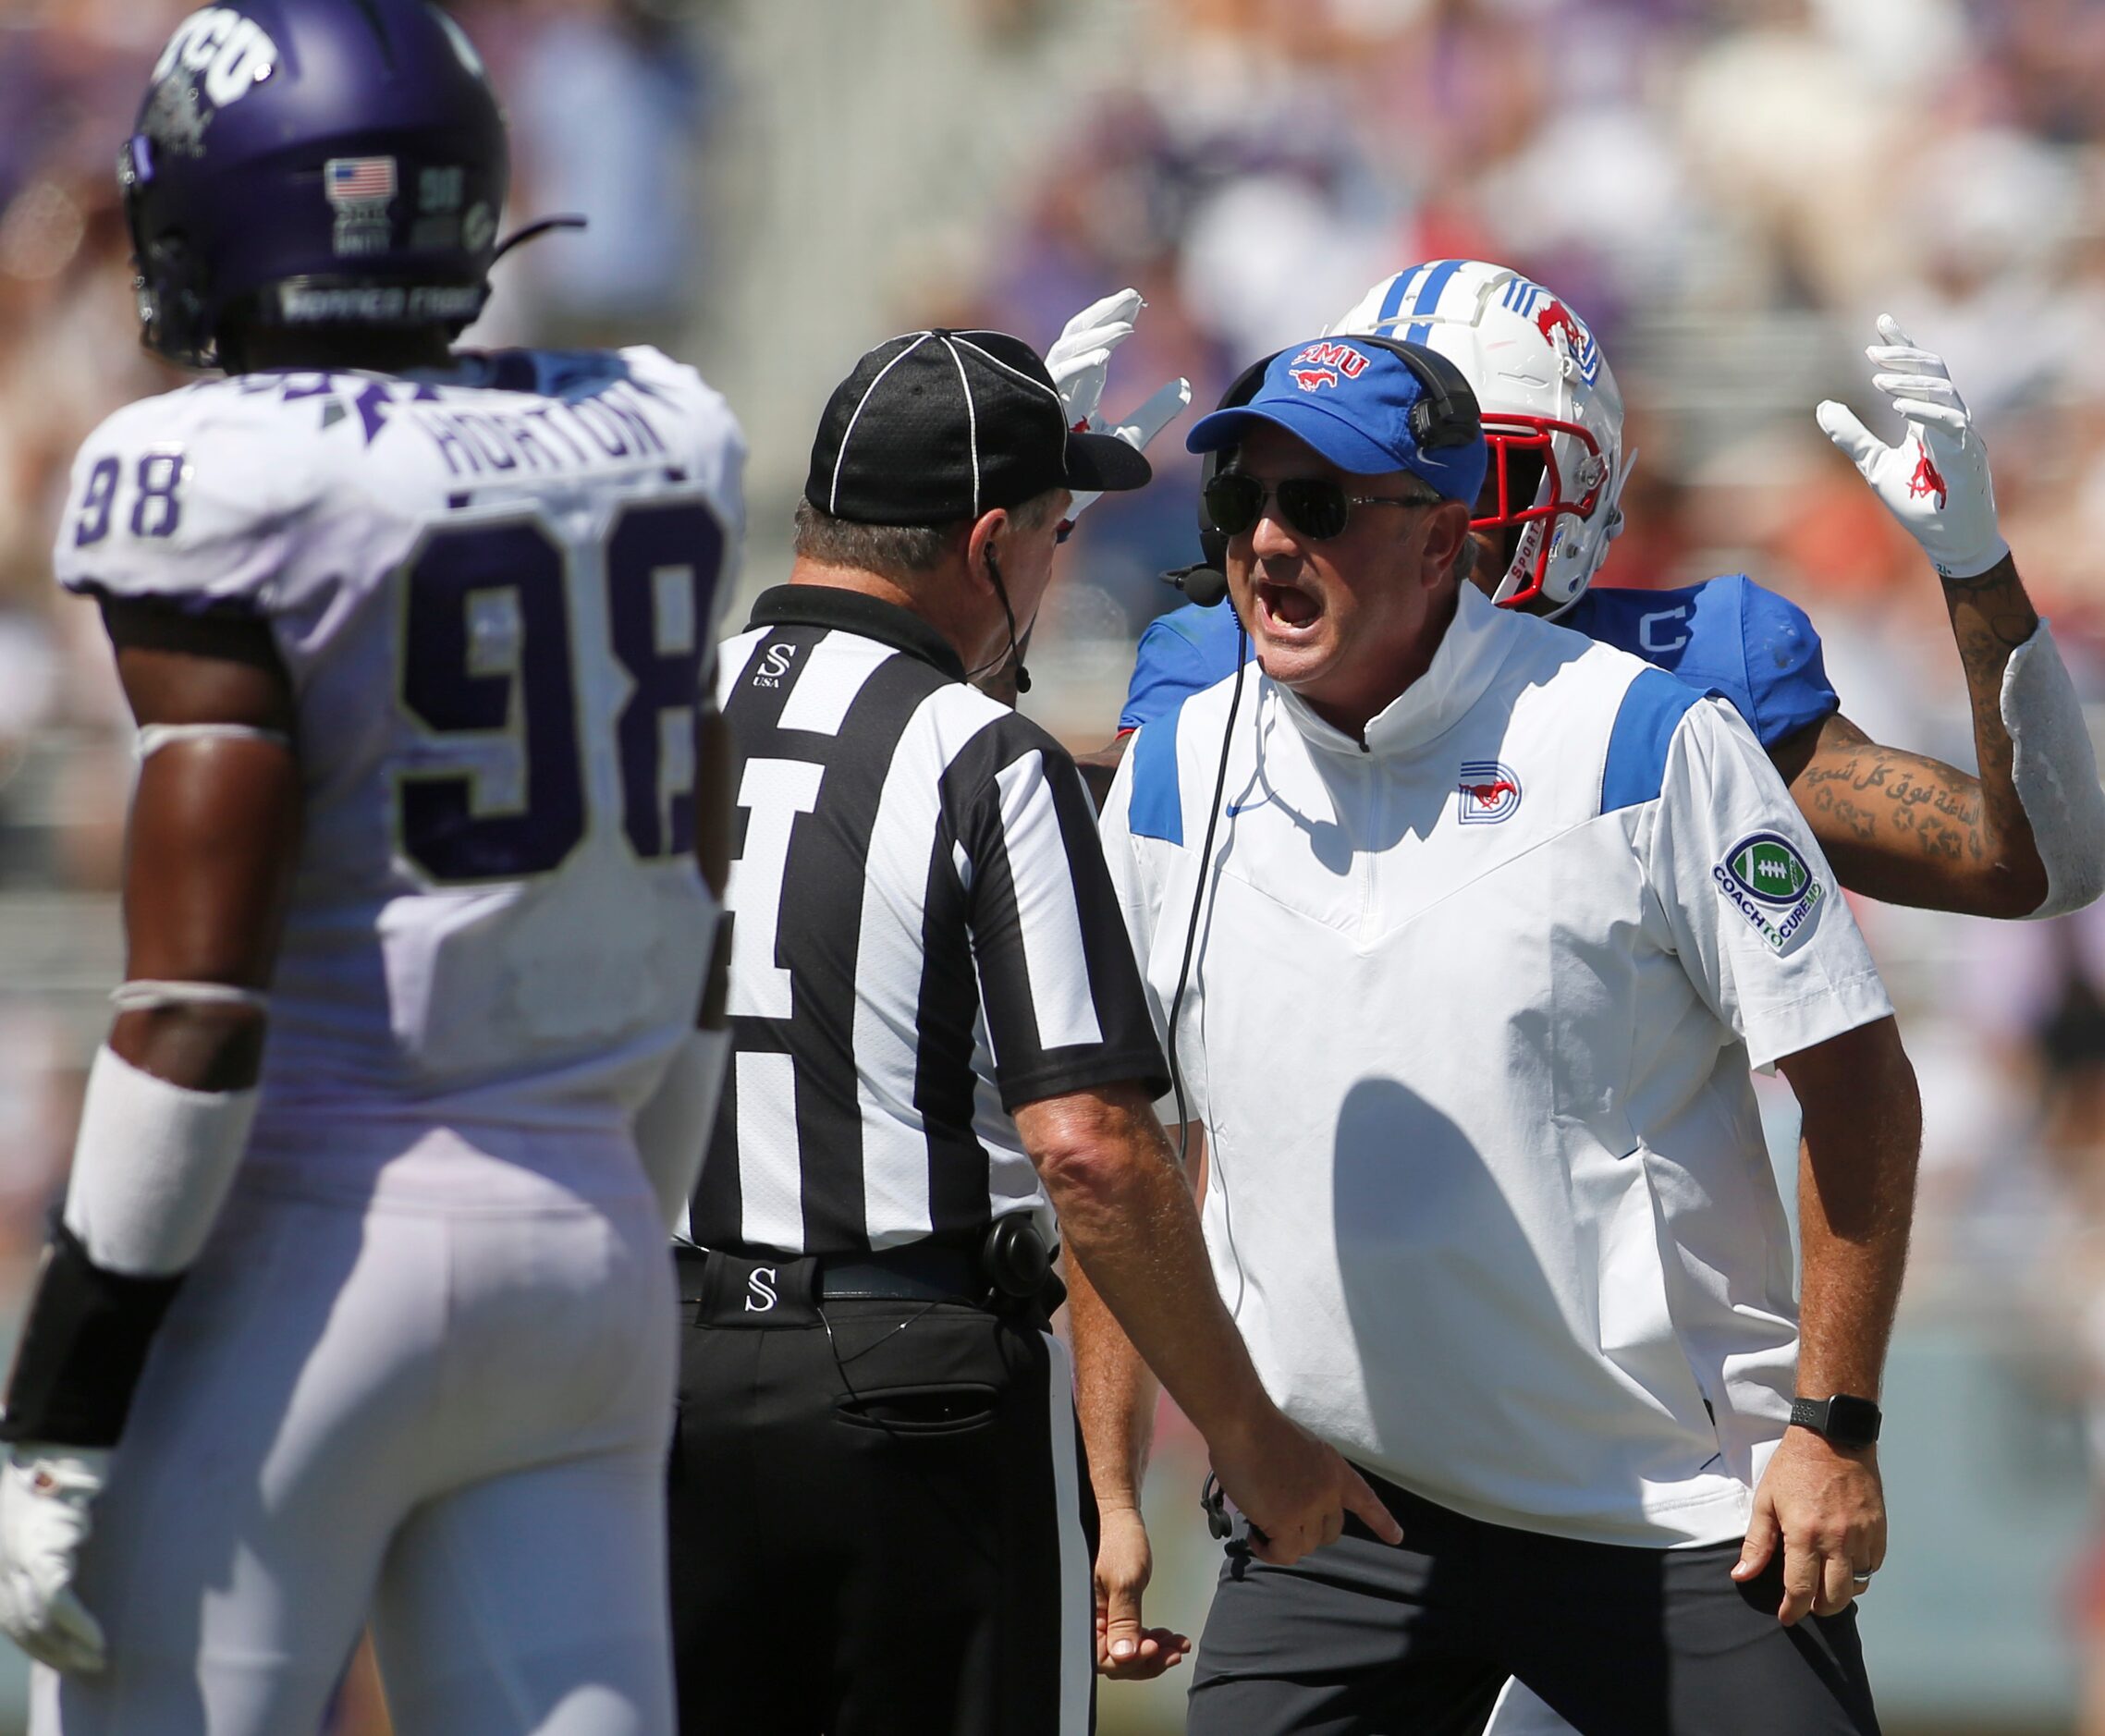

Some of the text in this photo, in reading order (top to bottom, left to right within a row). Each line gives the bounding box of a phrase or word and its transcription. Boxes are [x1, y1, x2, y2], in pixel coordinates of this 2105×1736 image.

[1291, 342, 1370, 379] SMU
[76, 449, 183, 547] 98
[1640, 605, 1687, 653] C
[753, 677, 780, 689] USA
[757, 643, 797, 678] S
[392, 495, 729, 886] 98
[1713, 865, 1766, 928] COACH
[744, 1267, 777, 1312] S
